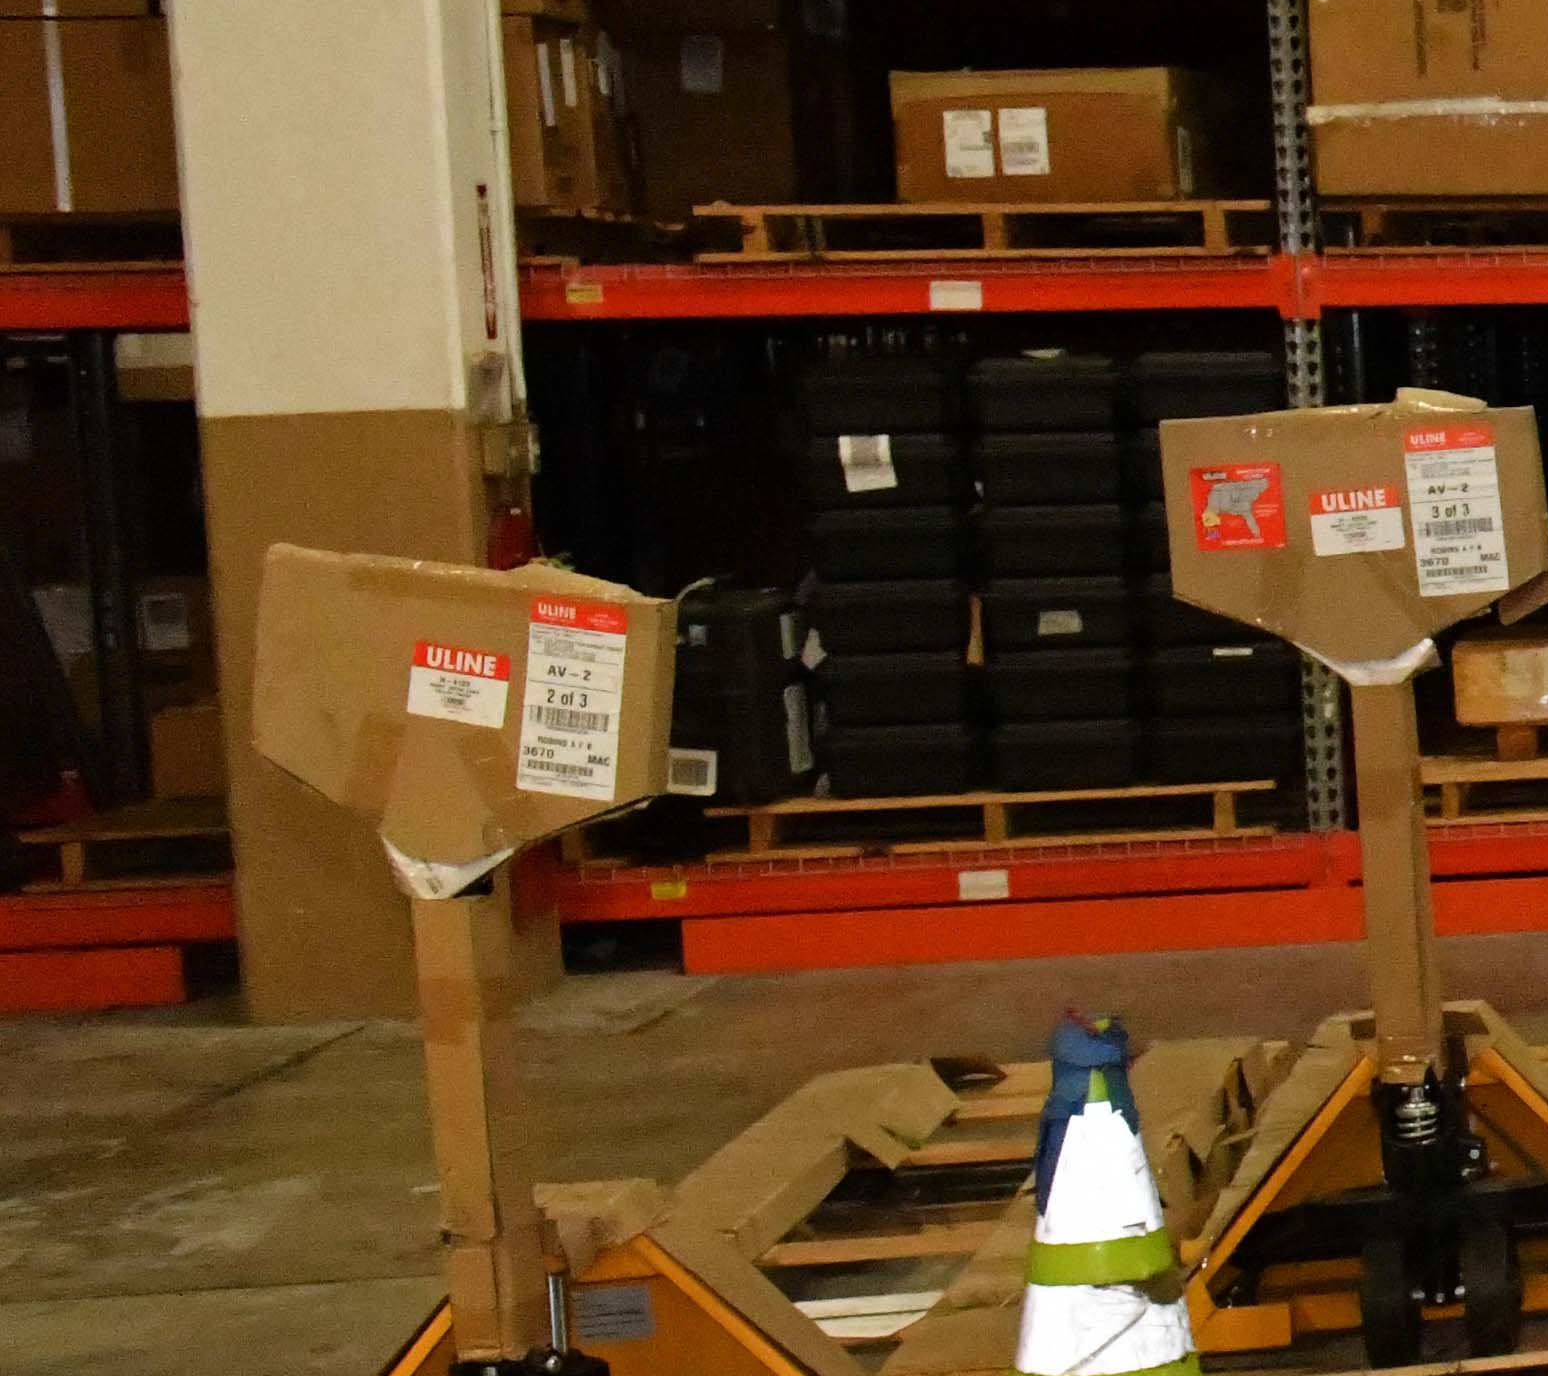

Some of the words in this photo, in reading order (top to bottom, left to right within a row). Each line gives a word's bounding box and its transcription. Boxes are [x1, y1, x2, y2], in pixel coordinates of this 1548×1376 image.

[1409, 431, 1447, 446] ULINE
[1320, 488, 1388, 513] ULINE
[1431, 505, 1441, 519] 3
[1445, 504, 1458, 518] of
[1462, 503, 1471, 517] 3
[538, 602, 577, 620] ULINE
[426, 645, 498, 677] ULINE
[547, 688, 556, 704] 2
[561, 692, 574, 706] of
[579, 693, 589, 708] 3
[522, 746, 555, 759] 3670
[587, 754, 611, 767] MAC
